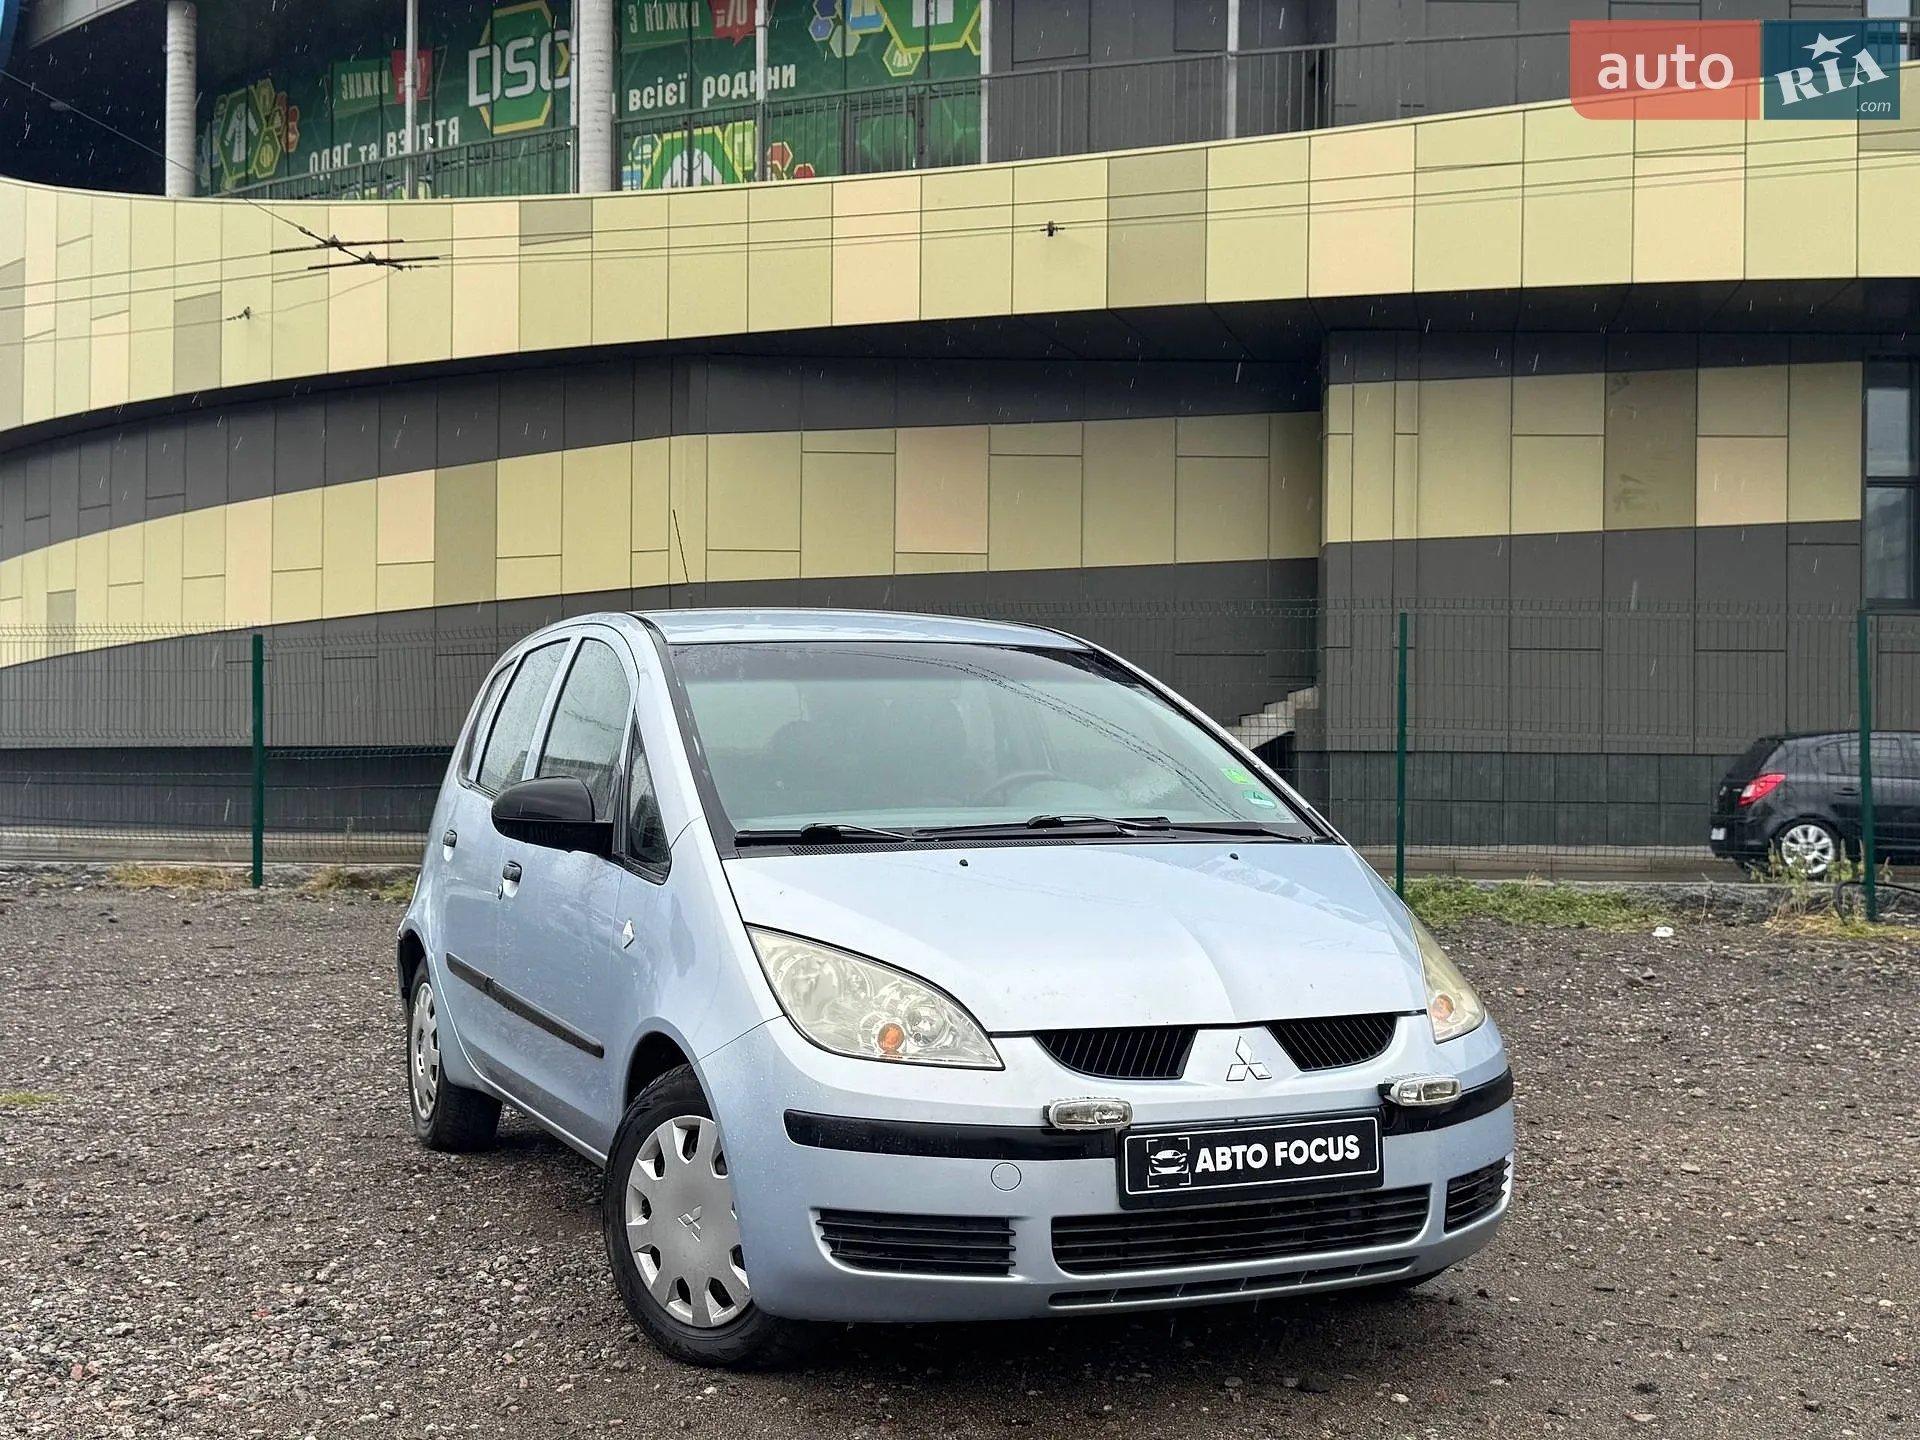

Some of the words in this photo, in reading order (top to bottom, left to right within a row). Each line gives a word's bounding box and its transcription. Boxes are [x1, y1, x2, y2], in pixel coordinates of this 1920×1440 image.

[628, 72, 688, 112] всієї
[358, 142, 378, 163] та
[1195, 1143, 1269, 1174] АВТО
[1274, 1135, 1361, 1171] FOCUS
